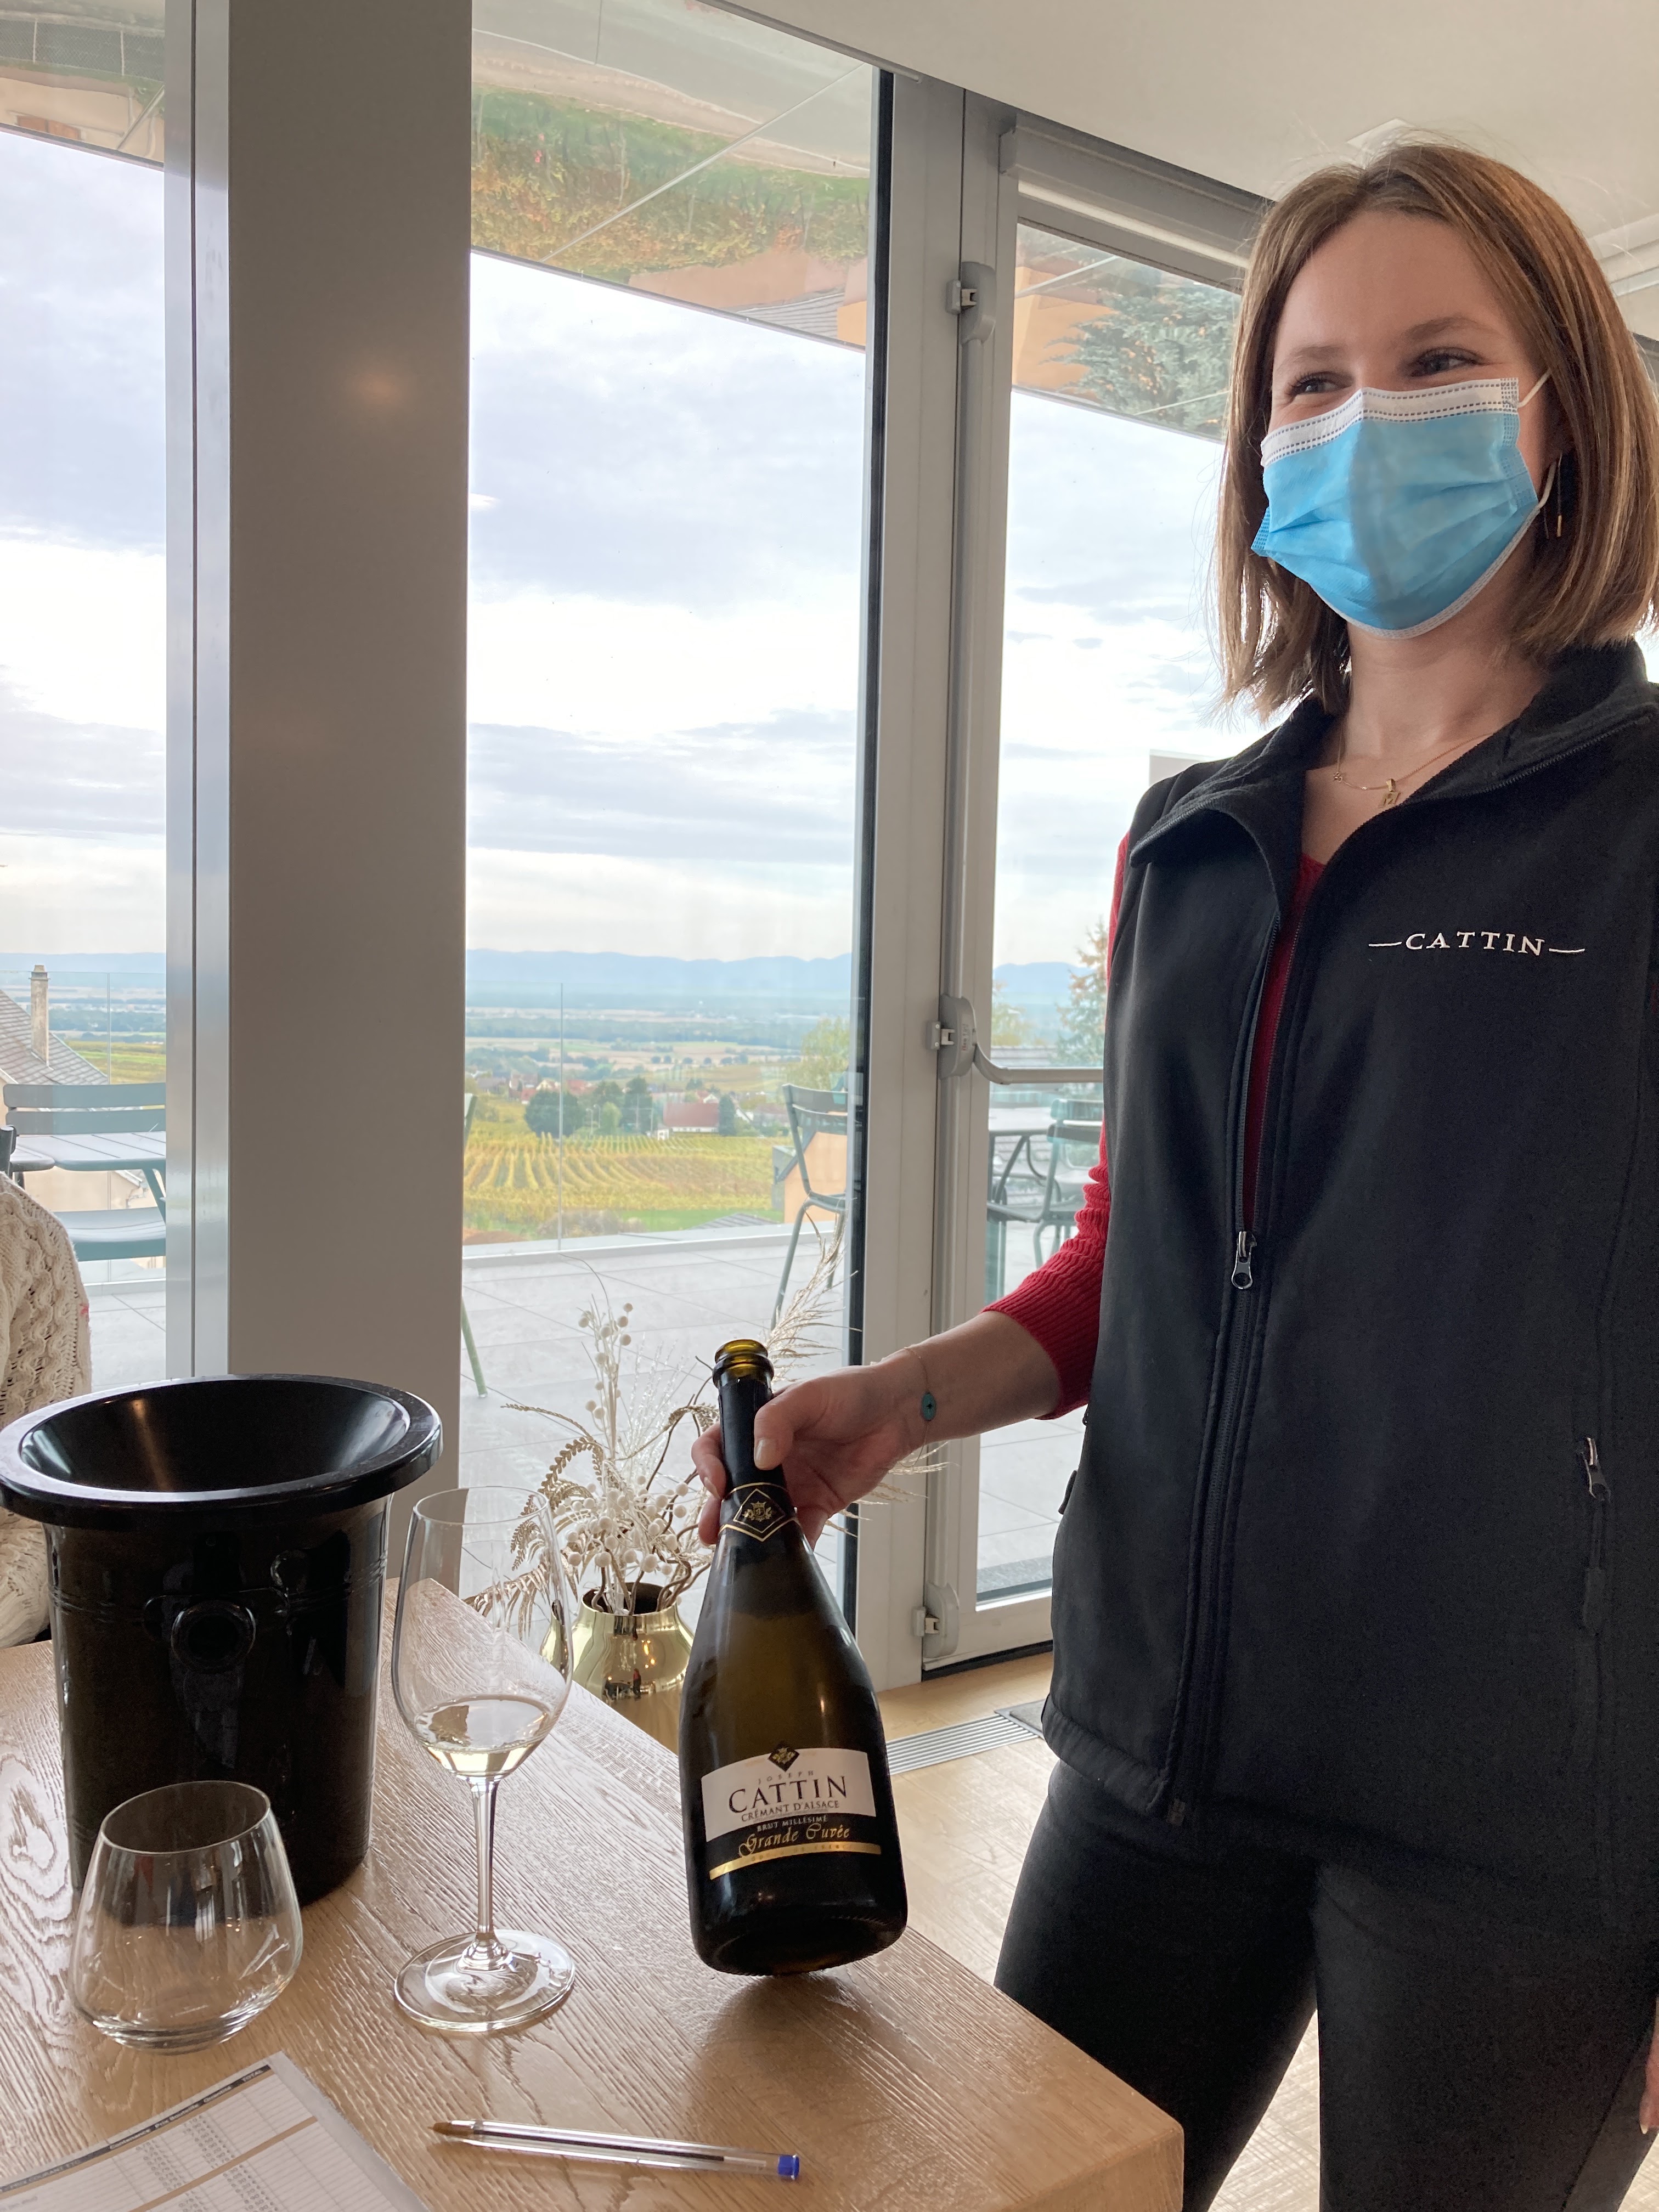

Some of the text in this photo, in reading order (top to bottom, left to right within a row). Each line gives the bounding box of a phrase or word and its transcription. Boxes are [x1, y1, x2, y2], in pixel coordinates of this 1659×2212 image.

[1406, 931, 1545, 956] CATTIN
[758, 1770, 814, 1784] JOSEPH
[729, 1775, 847, 1813] CATTIN
[741, 1804, 789, 1822] CRÉMANT
[794, 1800, 840, 1811] D'ALSACE
[757, 1821, 778, 1832] BRUT
[738, 1826, 799, 1858] Grande
[806, 1822, 850, 1839] Cuvée
[241, 2069, 264, 2083] TOTAL
